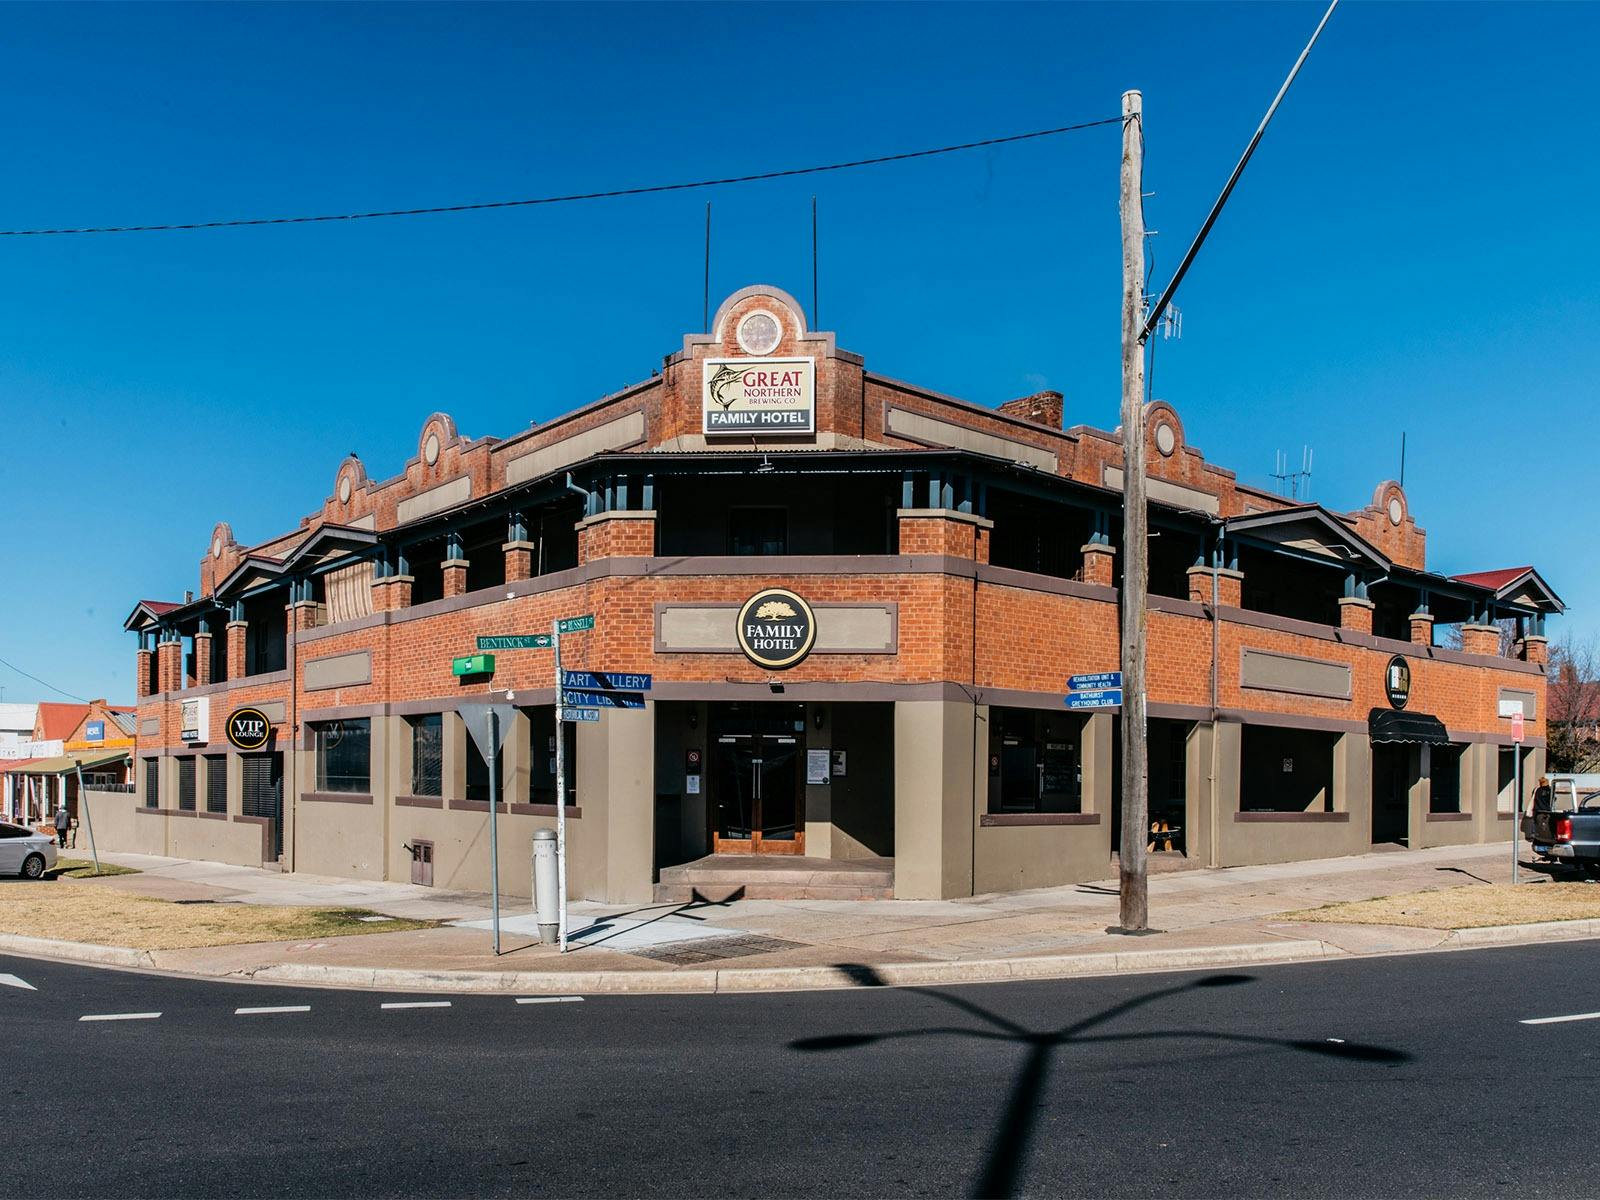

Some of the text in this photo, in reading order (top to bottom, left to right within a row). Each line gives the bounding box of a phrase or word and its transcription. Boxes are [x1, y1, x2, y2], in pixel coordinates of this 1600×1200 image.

[743, 371, 803, 387] GREAT
[744, 388, 801, 397] NORTHERN
[711, 412, 805, 424] FAMILY HOTEL
[567, 619, 589, 631] RUSSELL
[746, 625, 805, 637] FAMILY
[480, 637, 524, 648] BENTINCK
[753, 639, 797, 650] HOTEL
[568, 674, 591, 686] ART
[567, 691, 590, 704] CITY
[235, 719, 264, 732] VIP
